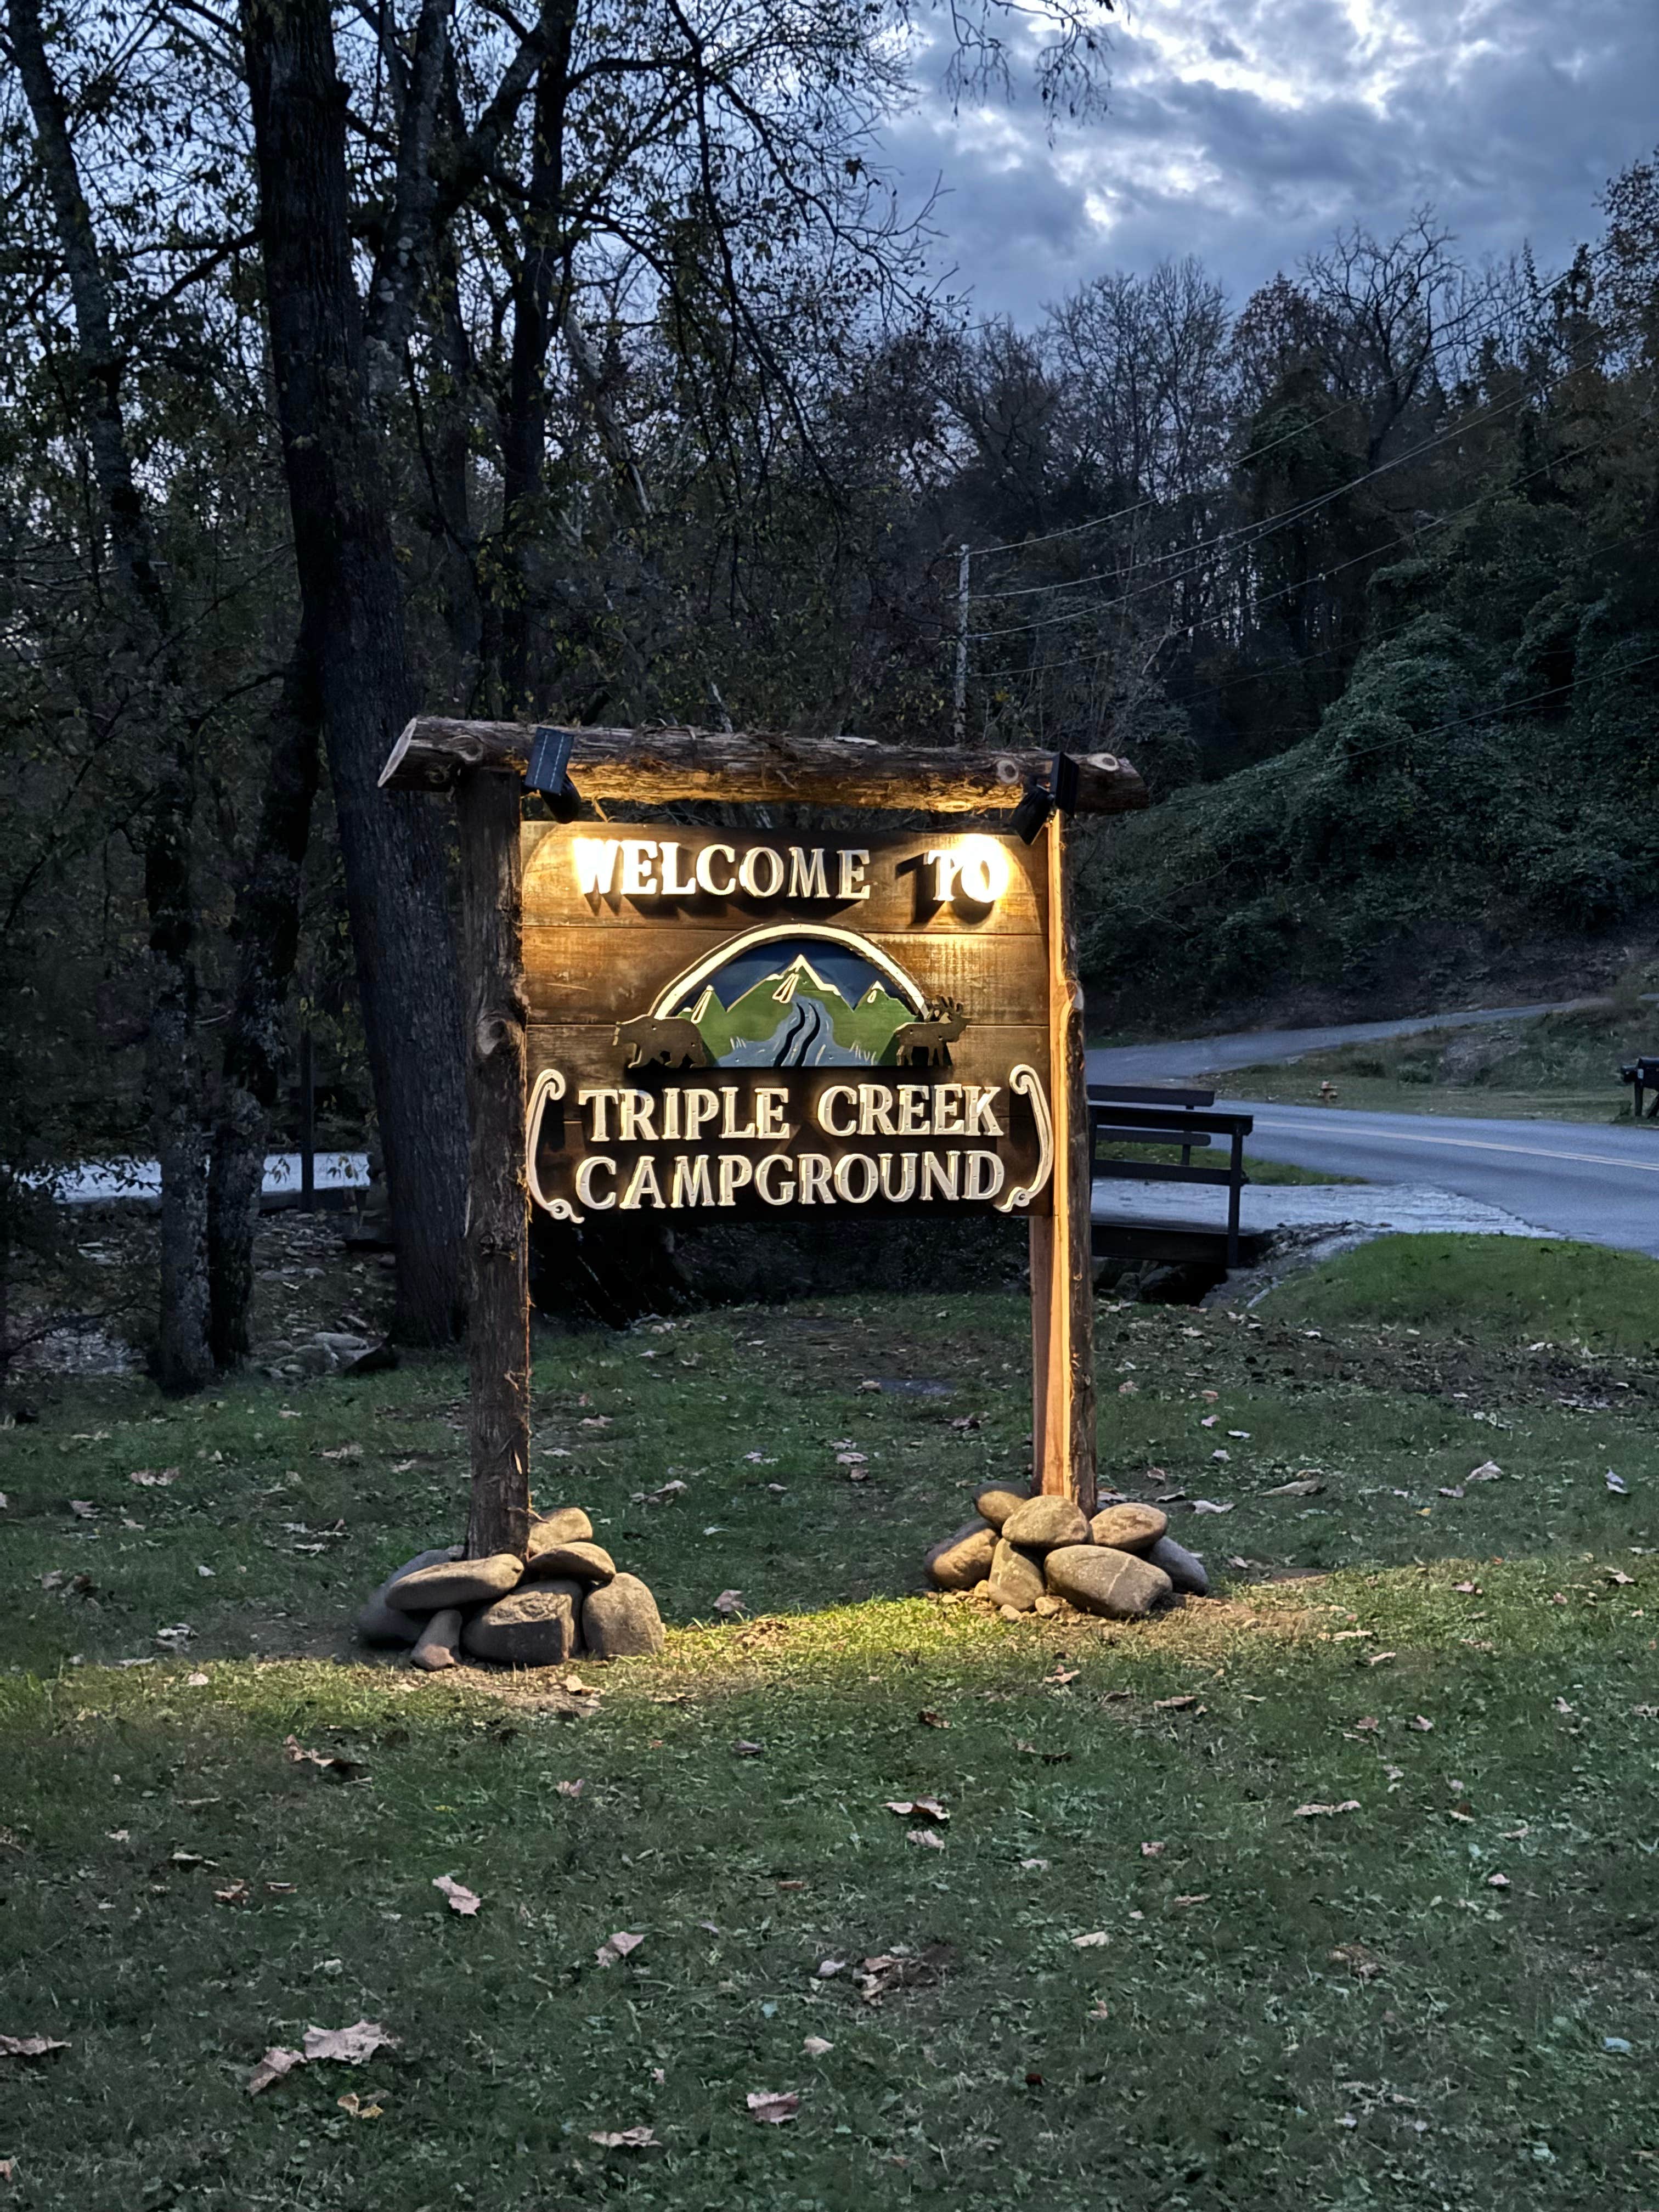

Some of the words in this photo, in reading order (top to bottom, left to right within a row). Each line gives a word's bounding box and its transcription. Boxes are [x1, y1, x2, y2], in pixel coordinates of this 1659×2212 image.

[572, 838, 871, 899] WELCOME
[924, 842, 1004, 903] TO
[578, 1086, 790, 1141] TRIPLE
[817, 1084, 1005, 1136] CREEK
[575, 1150, 1003, 1209] CAMPGROUND
